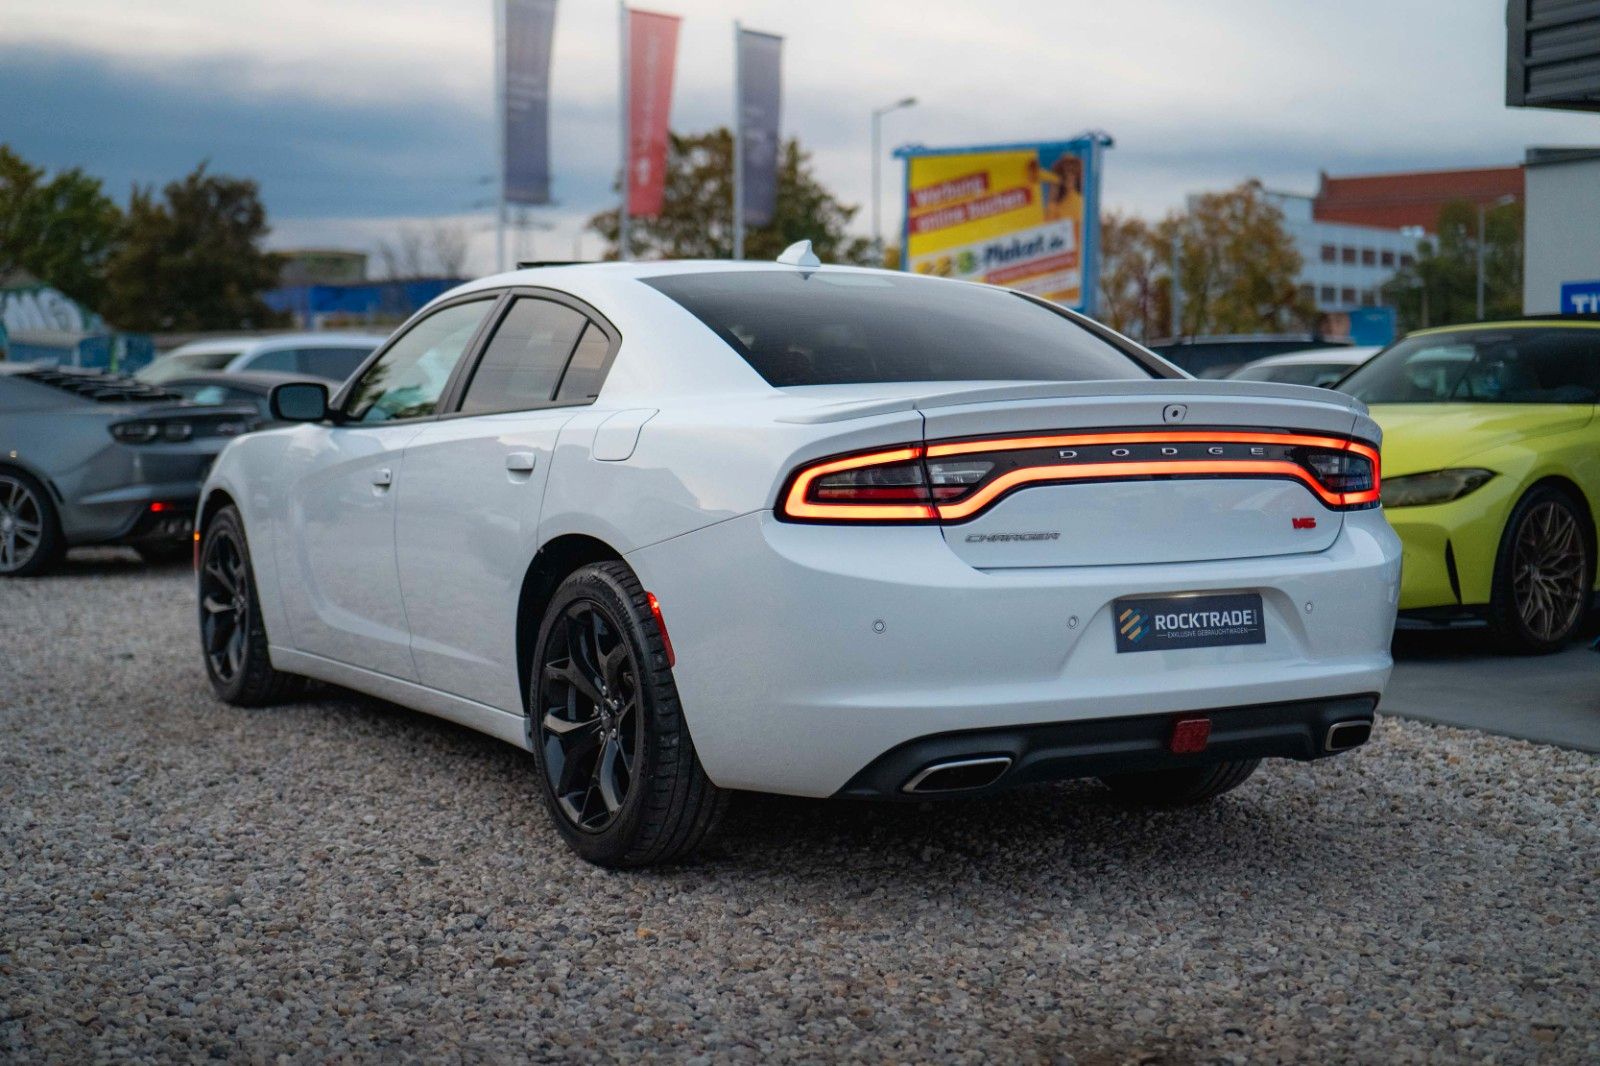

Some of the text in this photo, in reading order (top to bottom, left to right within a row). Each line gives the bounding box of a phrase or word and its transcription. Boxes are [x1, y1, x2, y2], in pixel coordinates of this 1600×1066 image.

[1059, 447, 1264, 459] DODGE
[1292, 517, 1316, 529] V6
[965, 532, 1060, 543] CHARGER
[1155, 610, 1252, 630] ROCKTRADE
[1168, 630, 1197, 639] EXKLUSIVE
